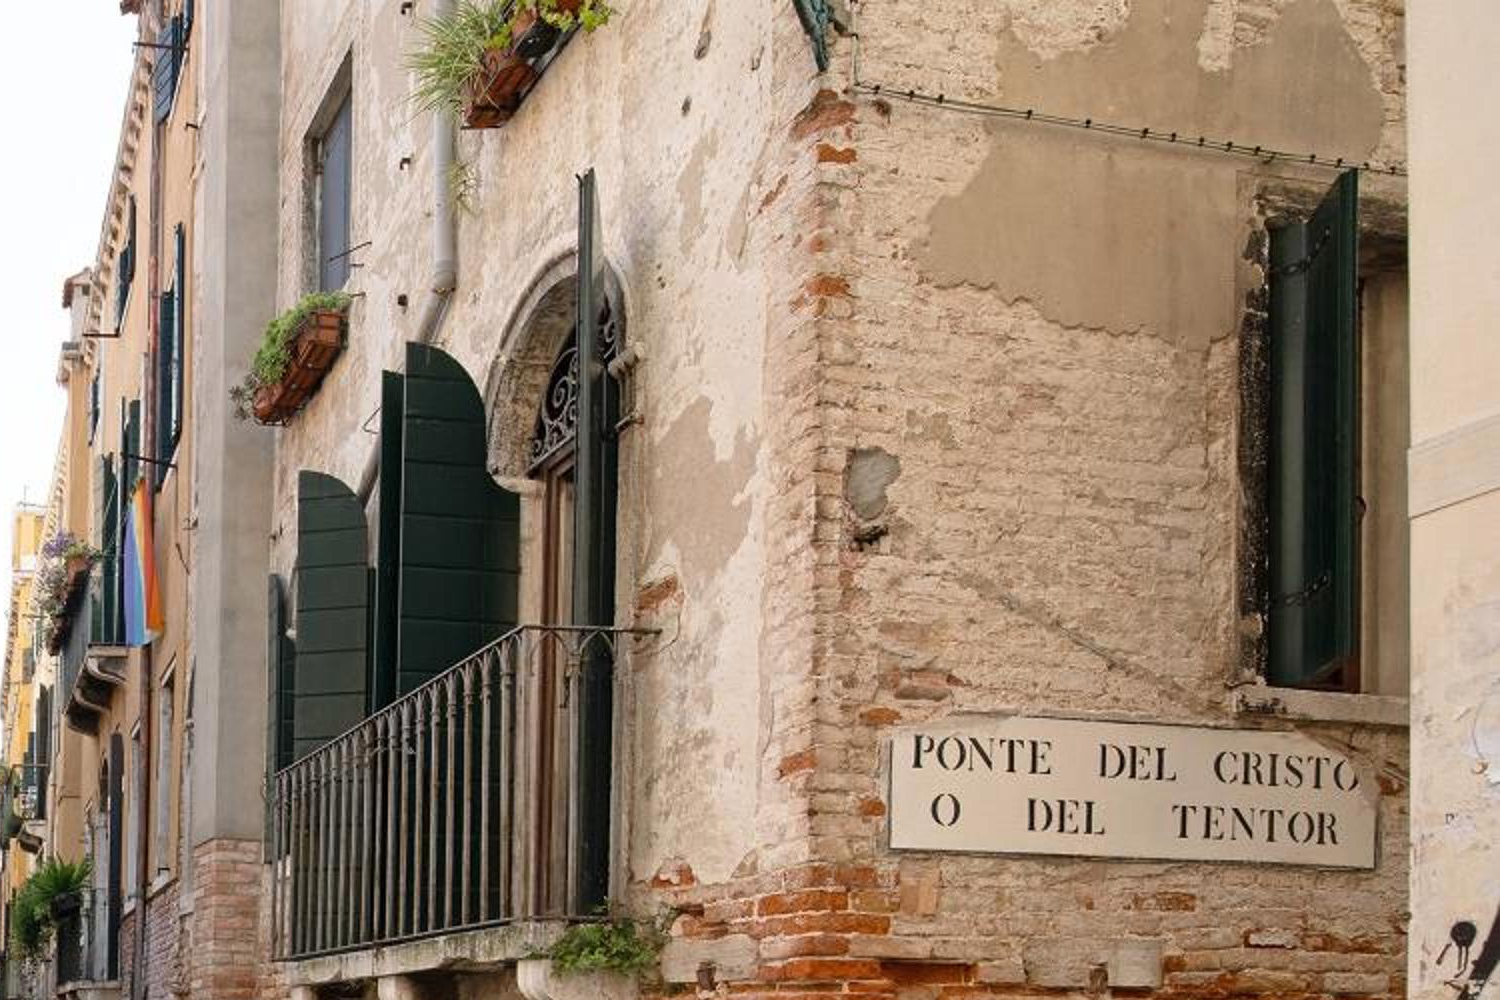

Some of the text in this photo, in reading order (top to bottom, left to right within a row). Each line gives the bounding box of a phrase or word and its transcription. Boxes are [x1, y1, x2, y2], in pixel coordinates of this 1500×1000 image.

[912, 734, 1359, 791] PONTE DEL CRISTO
[931, 793, 1339, 845] O DEL TENTOR
